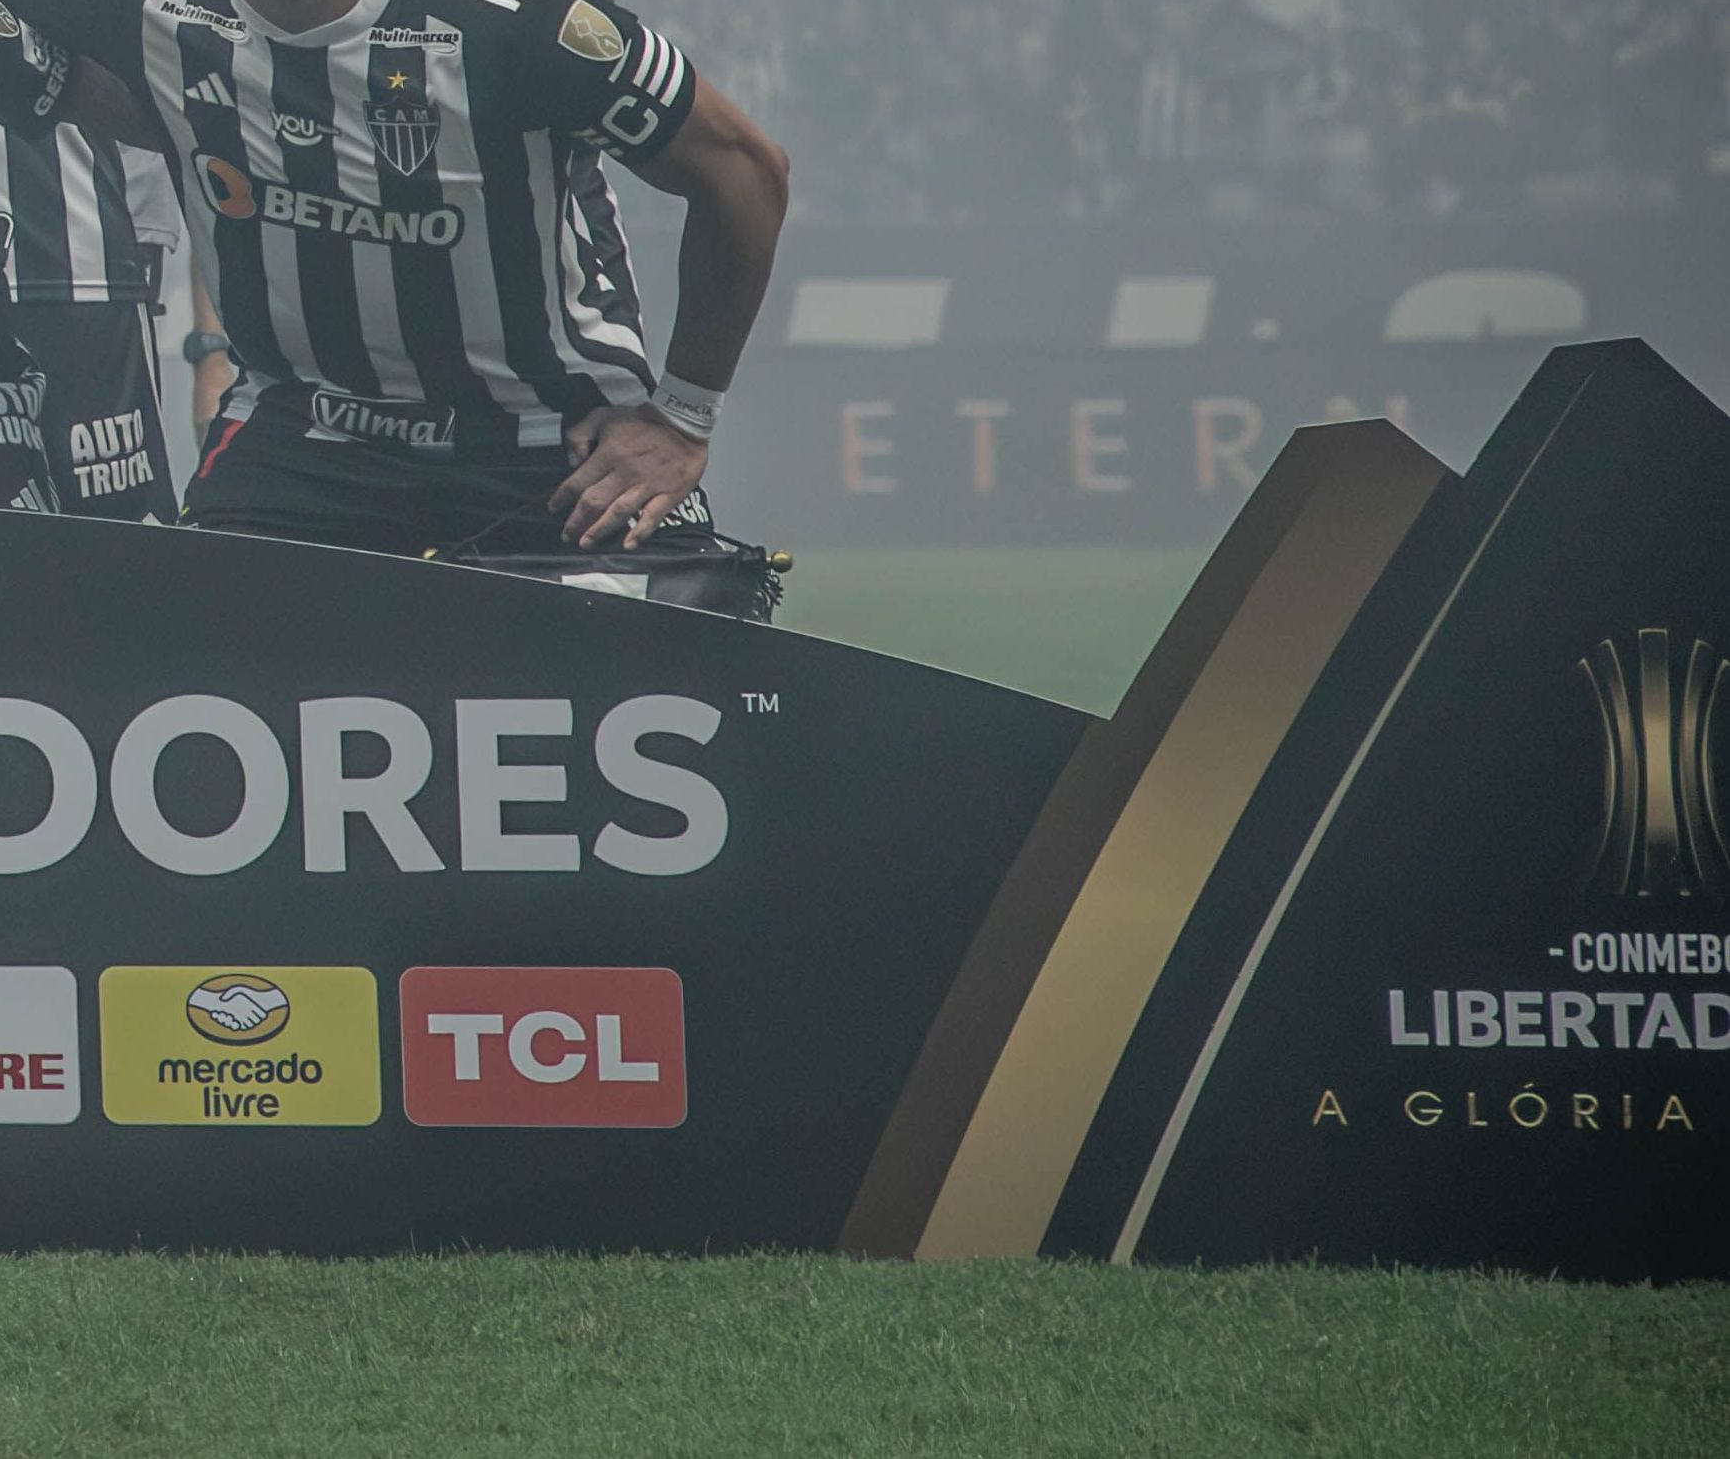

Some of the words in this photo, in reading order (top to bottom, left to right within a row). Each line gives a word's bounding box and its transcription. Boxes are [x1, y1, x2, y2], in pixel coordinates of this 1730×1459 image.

[161, 0, 247, 31] Multimarcas
[369, 29, 460, 43] Multimarcas
[272, 111, 315, 136] YOU
[375, 108, 429, 121] CAM
[603, 95, 659, 146] C
[264, 184, 459, 246] BETANO
[70, 408, 144, 466] AUTO
[318, 394, 438, 446] Vilma
[427, 1010, 660, 1084] TCL
[157, 1052, 323, 1085] mercado
[203, 1086, 280, 1119] livre
[1312, 1089, 1348, 1127] A
[1405, 1081, 1694, 1131] GLÓRIA
